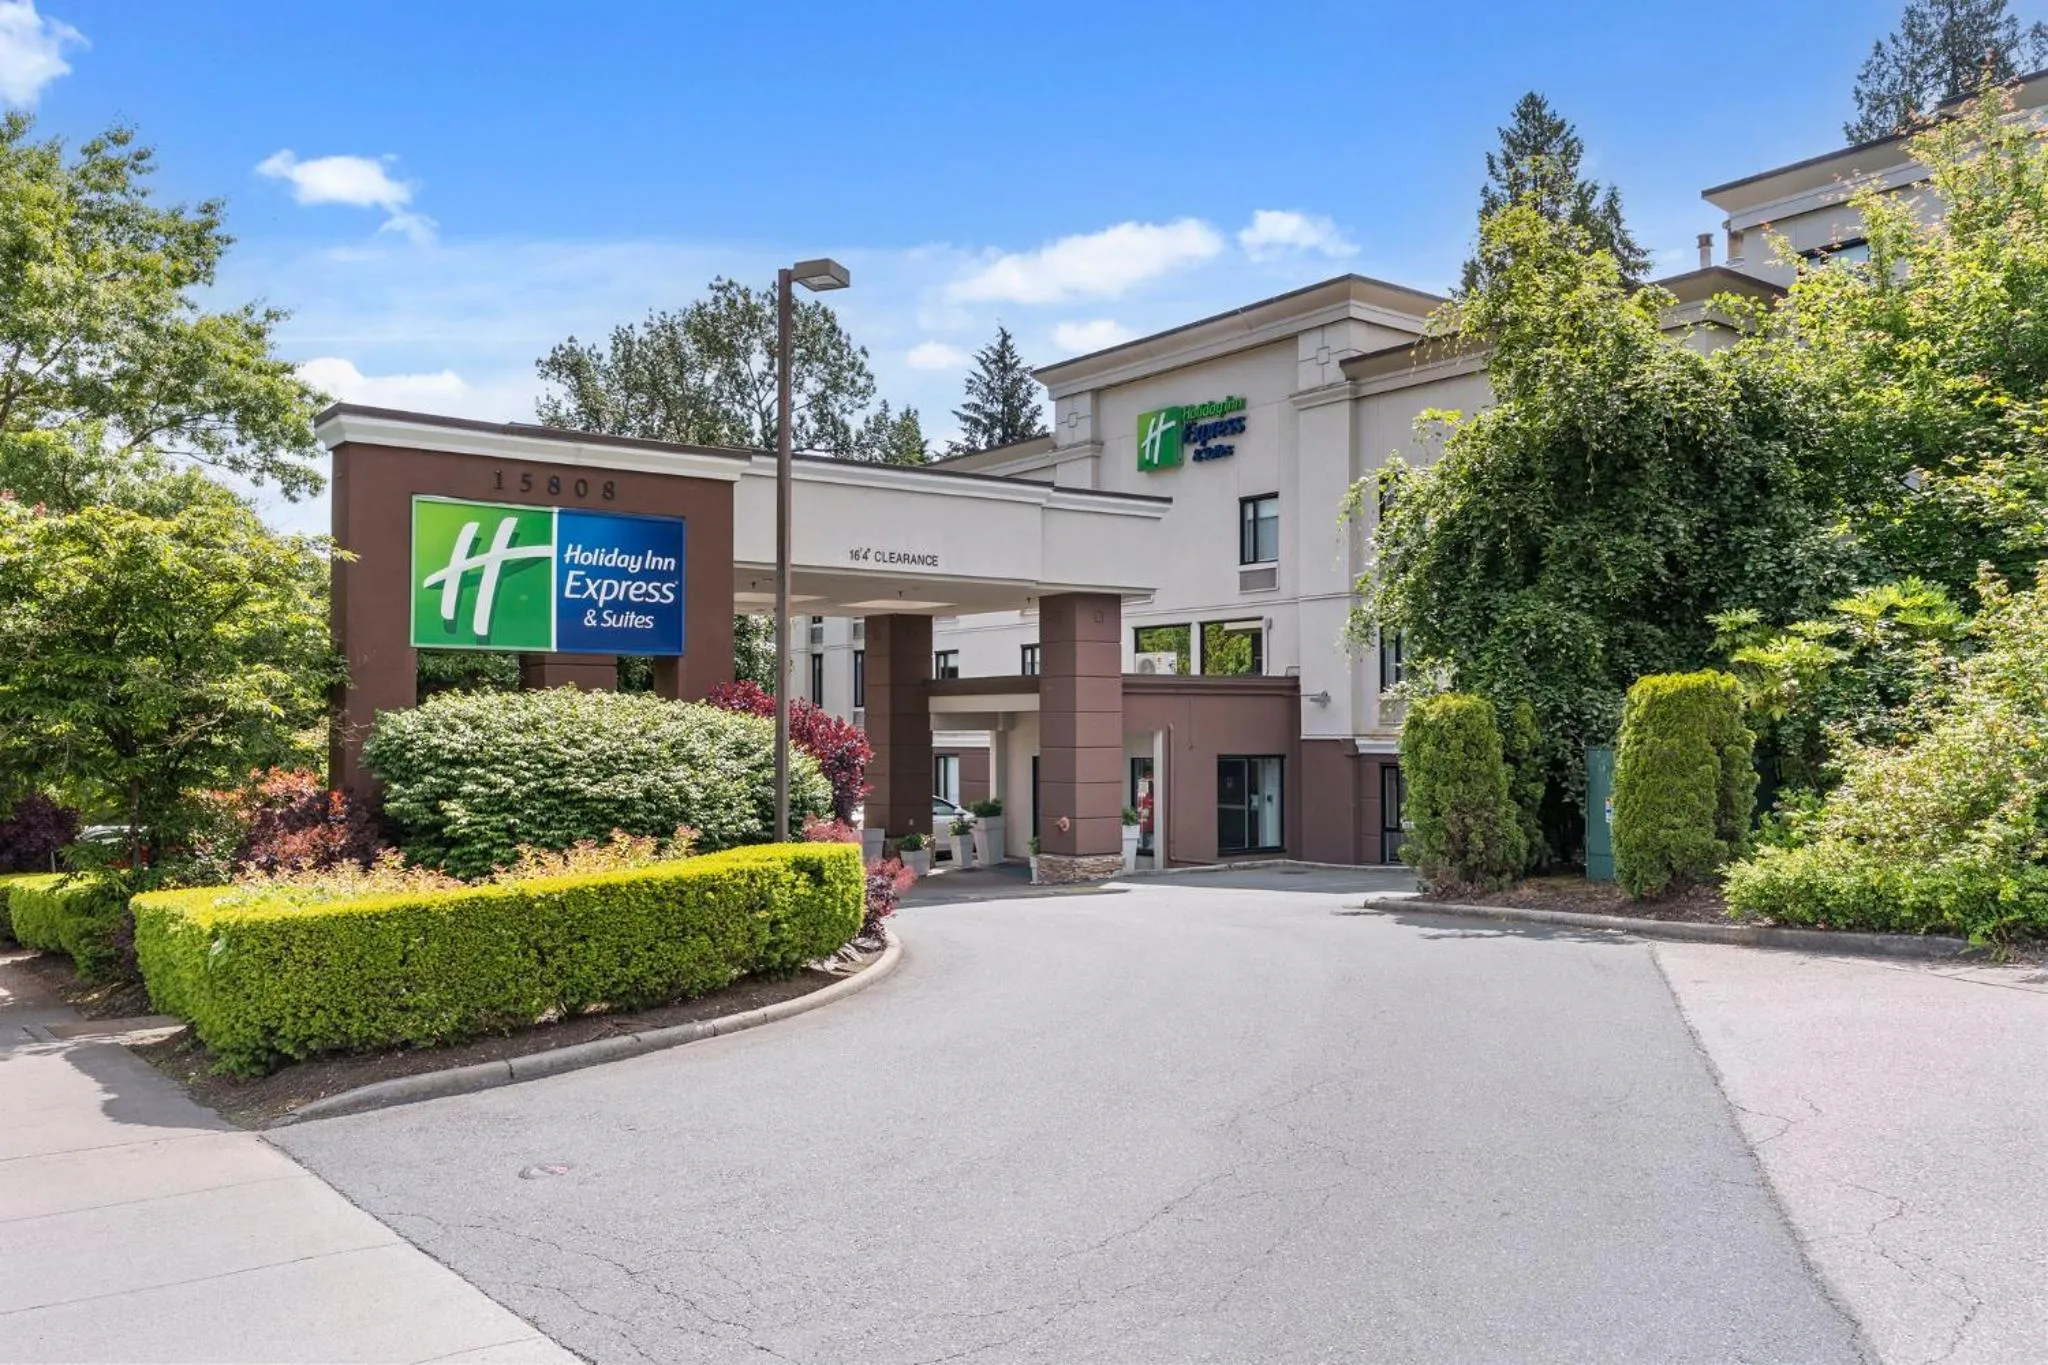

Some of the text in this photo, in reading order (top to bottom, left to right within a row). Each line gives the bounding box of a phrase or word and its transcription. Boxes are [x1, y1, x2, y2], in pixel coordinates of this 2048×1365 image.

[493, 470, 615, 500] 15808
[564, 544, 676, 573] Holiday Inn
[874, 551, 939, 567] CLEARANCE
[564, 570, 676, 608] Express
[583, 609, 655, 628] & Suites
